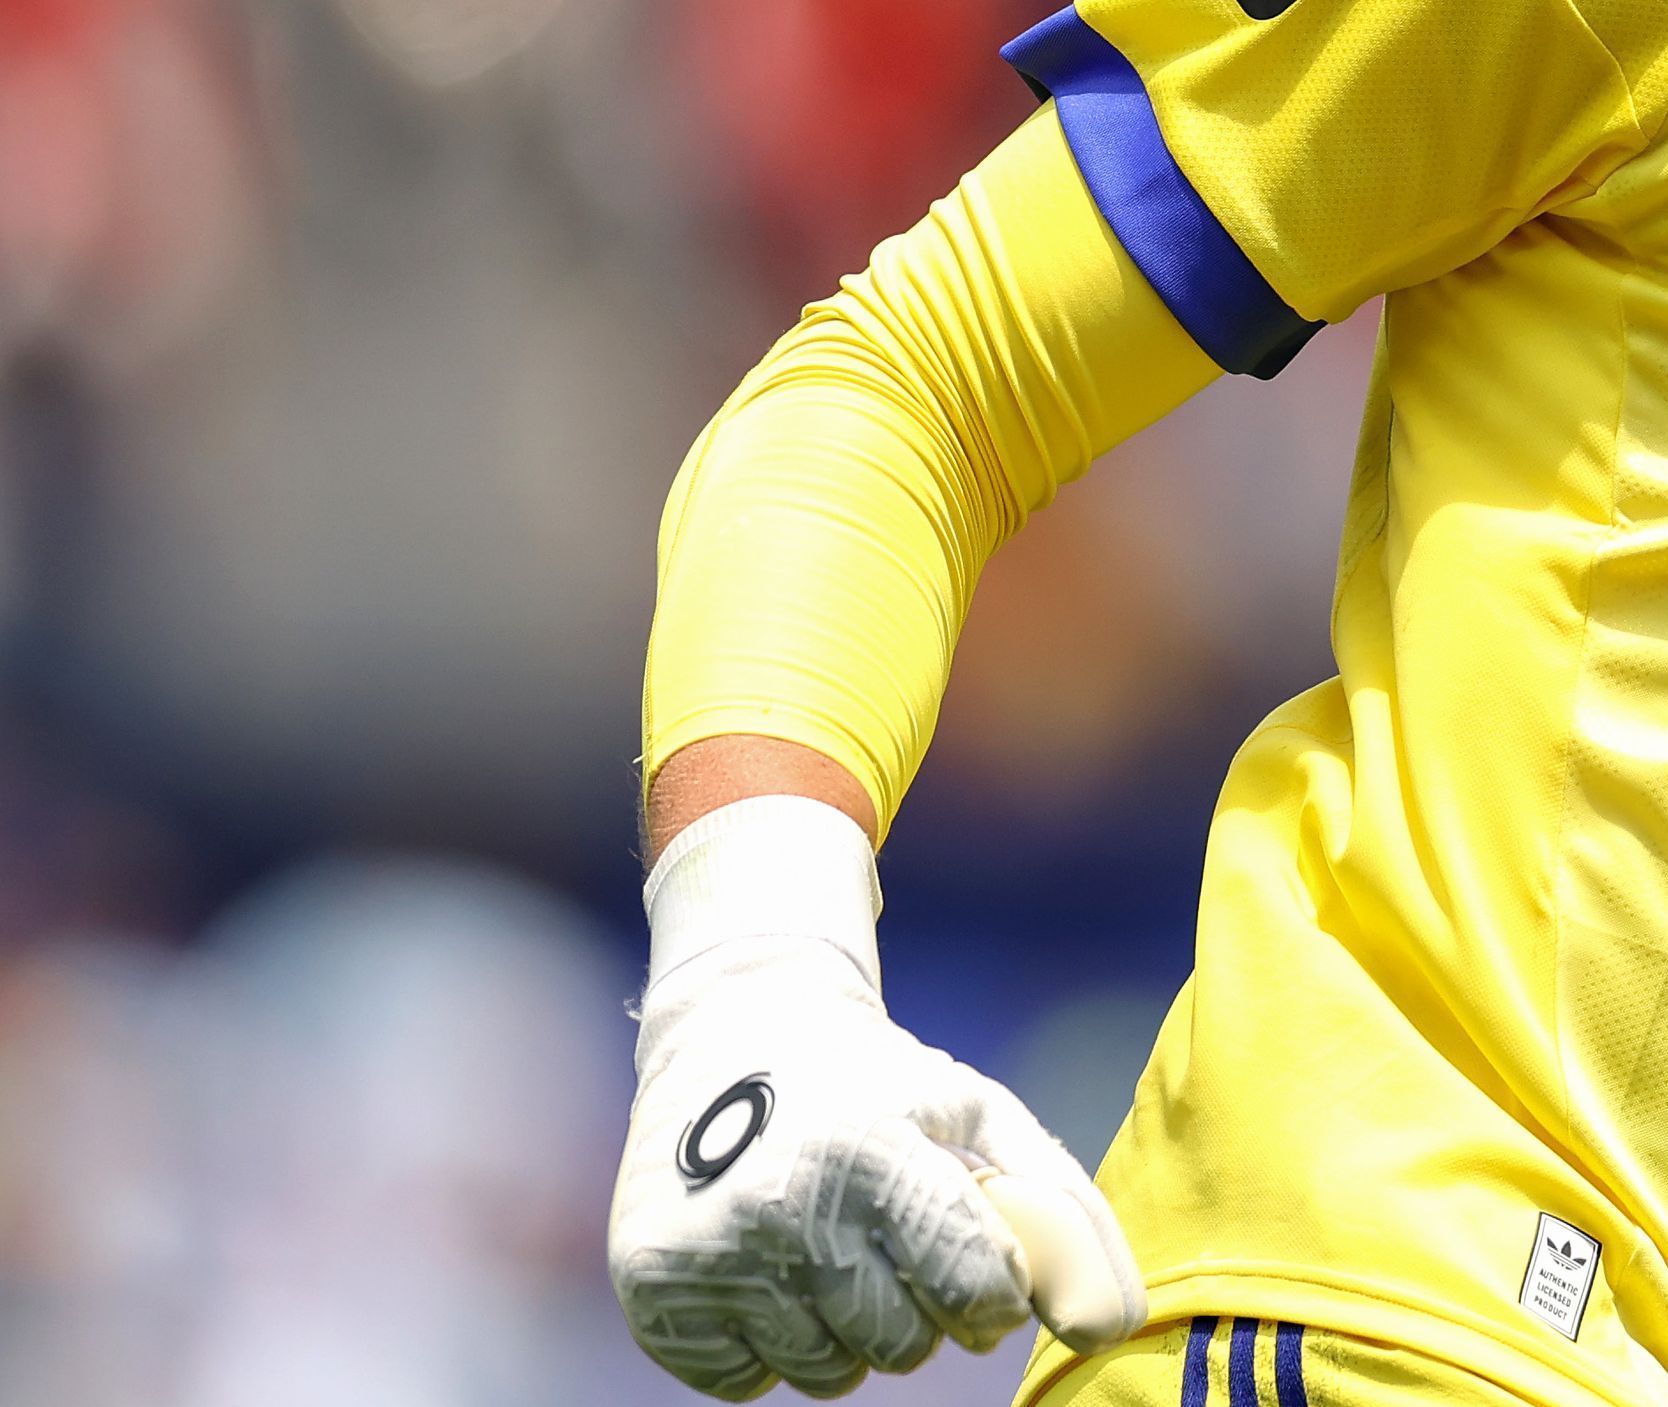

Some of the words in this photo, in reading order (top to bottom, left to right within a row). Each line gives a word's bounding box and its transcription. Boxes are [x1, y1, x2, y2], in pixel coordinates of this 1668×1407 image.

[1537, 1281, 1571, 1307] LICENSED
[1539, 1268, 1578, 1296] AUTHENTIC
[1534, 1295, 1567, 1320] PRODUCT
